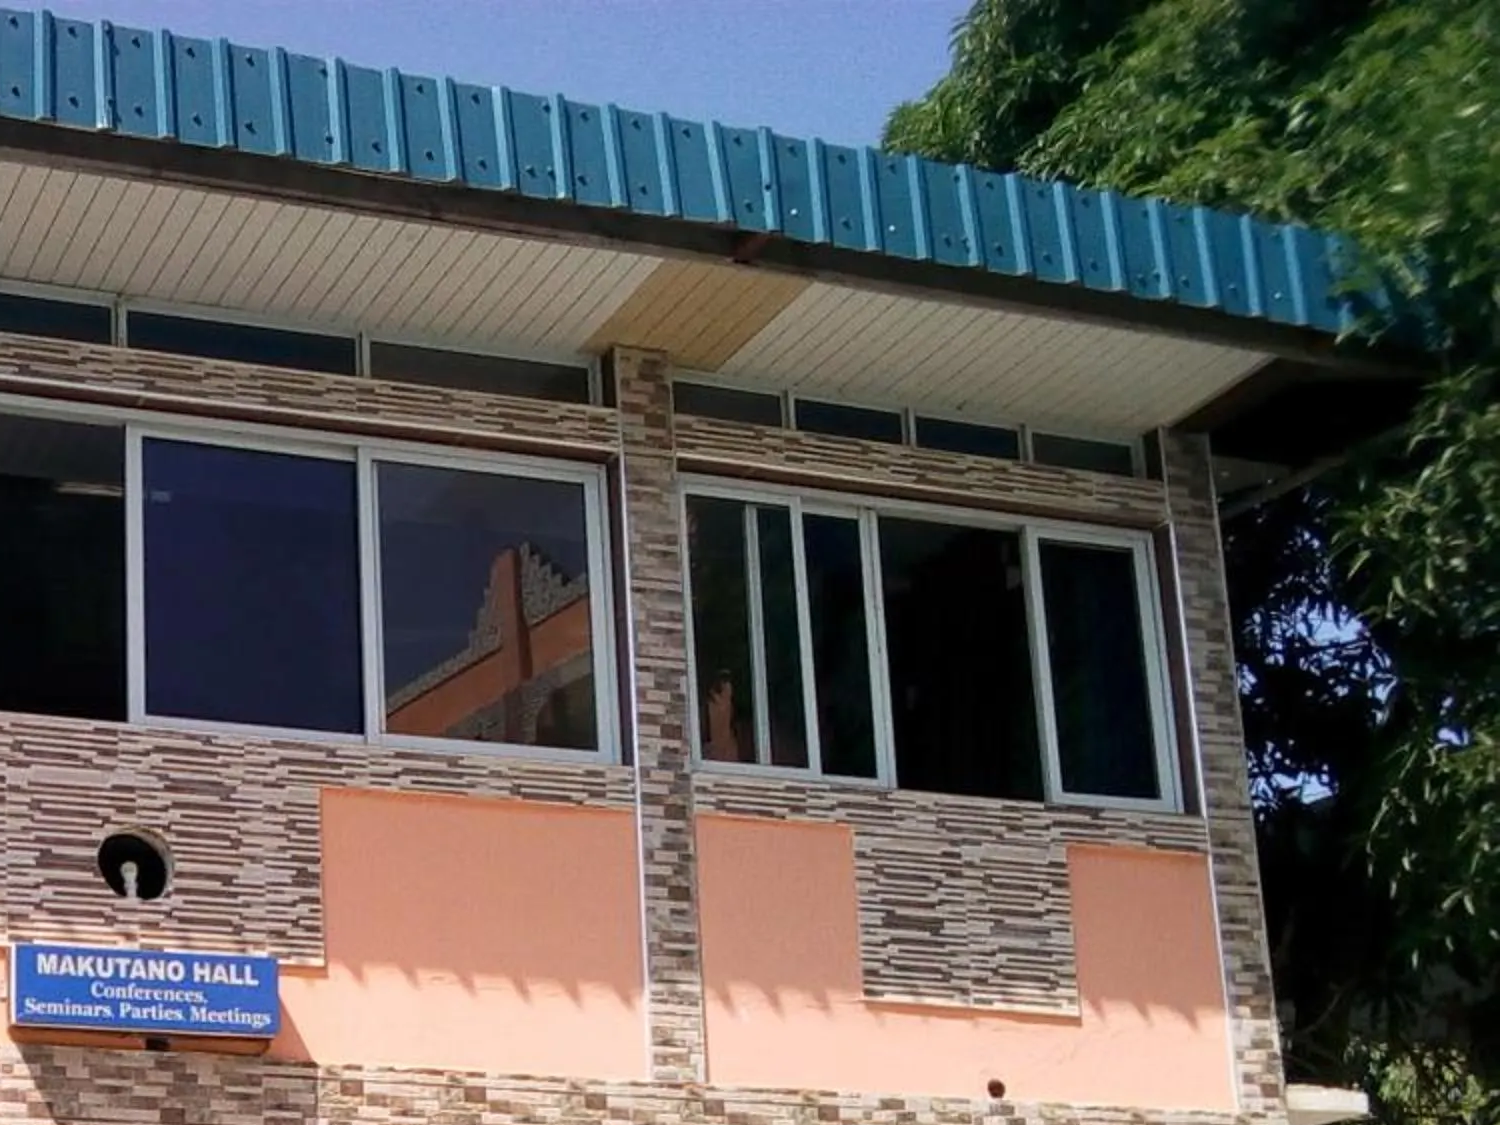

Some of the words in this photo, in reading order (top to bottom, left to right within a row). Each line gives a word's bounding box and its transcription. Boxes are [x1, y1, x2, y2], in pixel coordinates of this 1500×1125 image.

[37, 953, 185, 981] MAKUTANO
[193, 962, 259, 986] HALL
[91, 981, 208, 1003] Conferences,
[190, 1006, 271, 1028] Meetings
